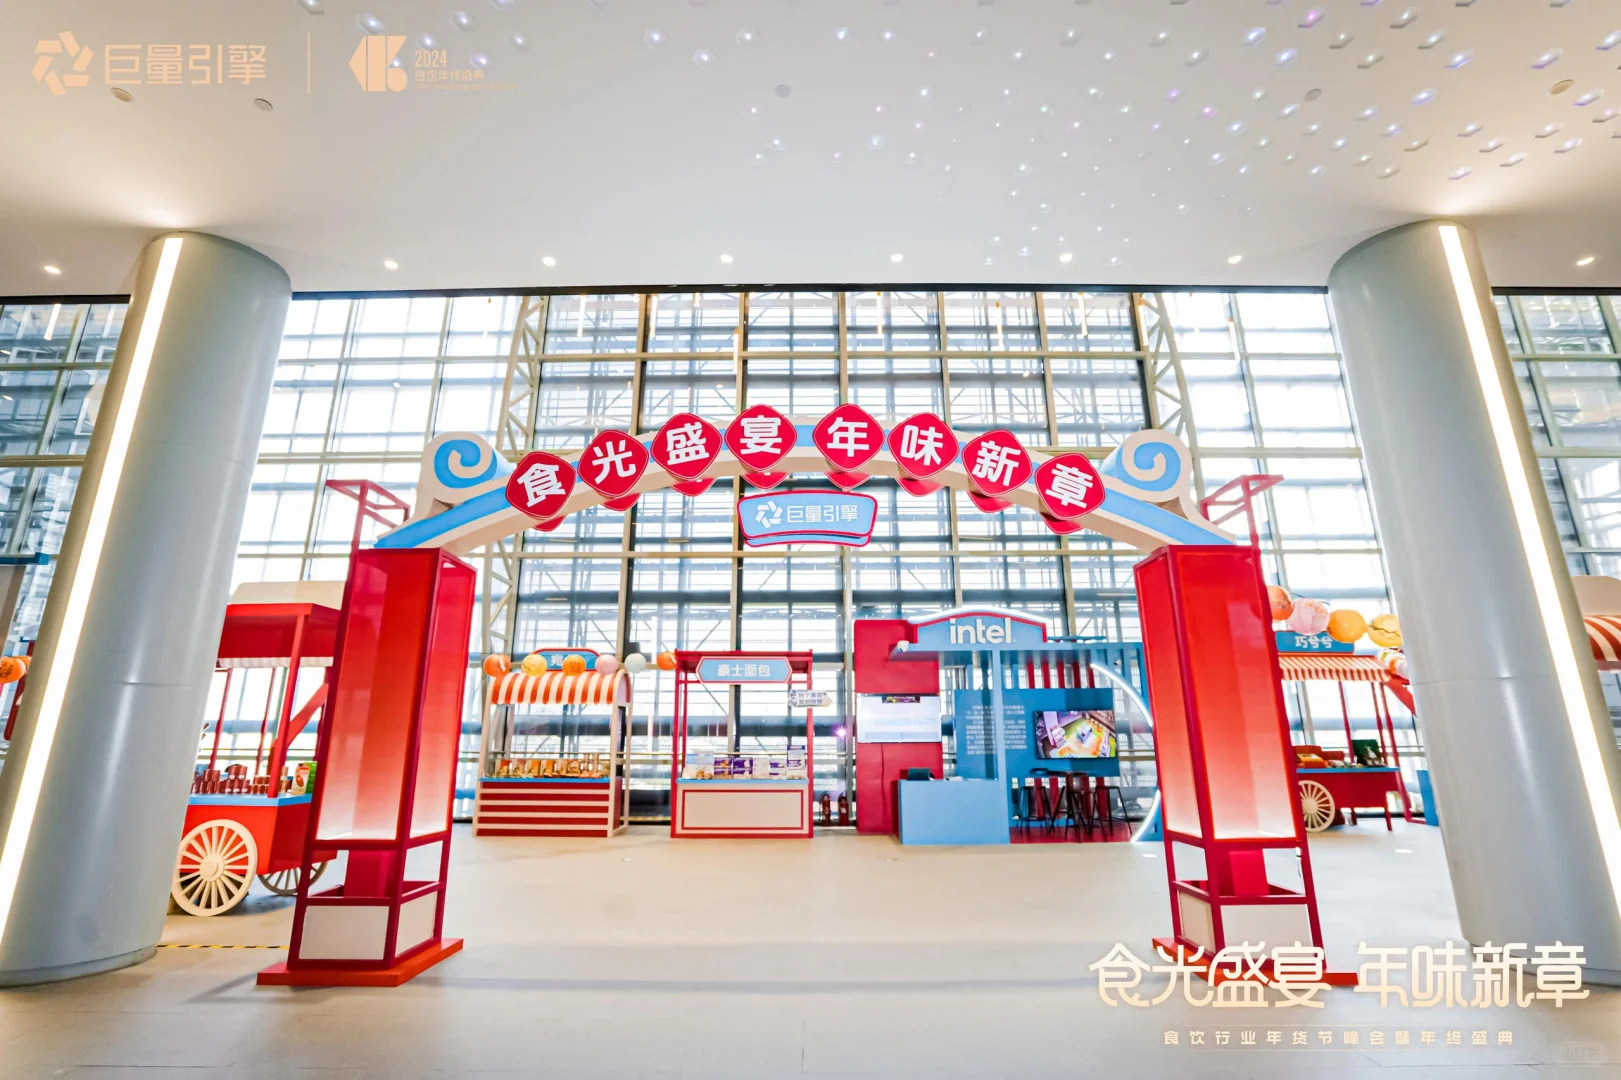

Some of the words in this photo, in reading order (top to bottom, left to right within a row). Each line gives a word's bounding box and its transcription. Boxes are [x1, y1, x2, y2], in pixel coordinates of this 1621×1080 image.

[787, 504, 859, 523] 巨量引擎
[949, 617, 1012, 644] intel
[717, 663, 771, 677] 豪士面包
